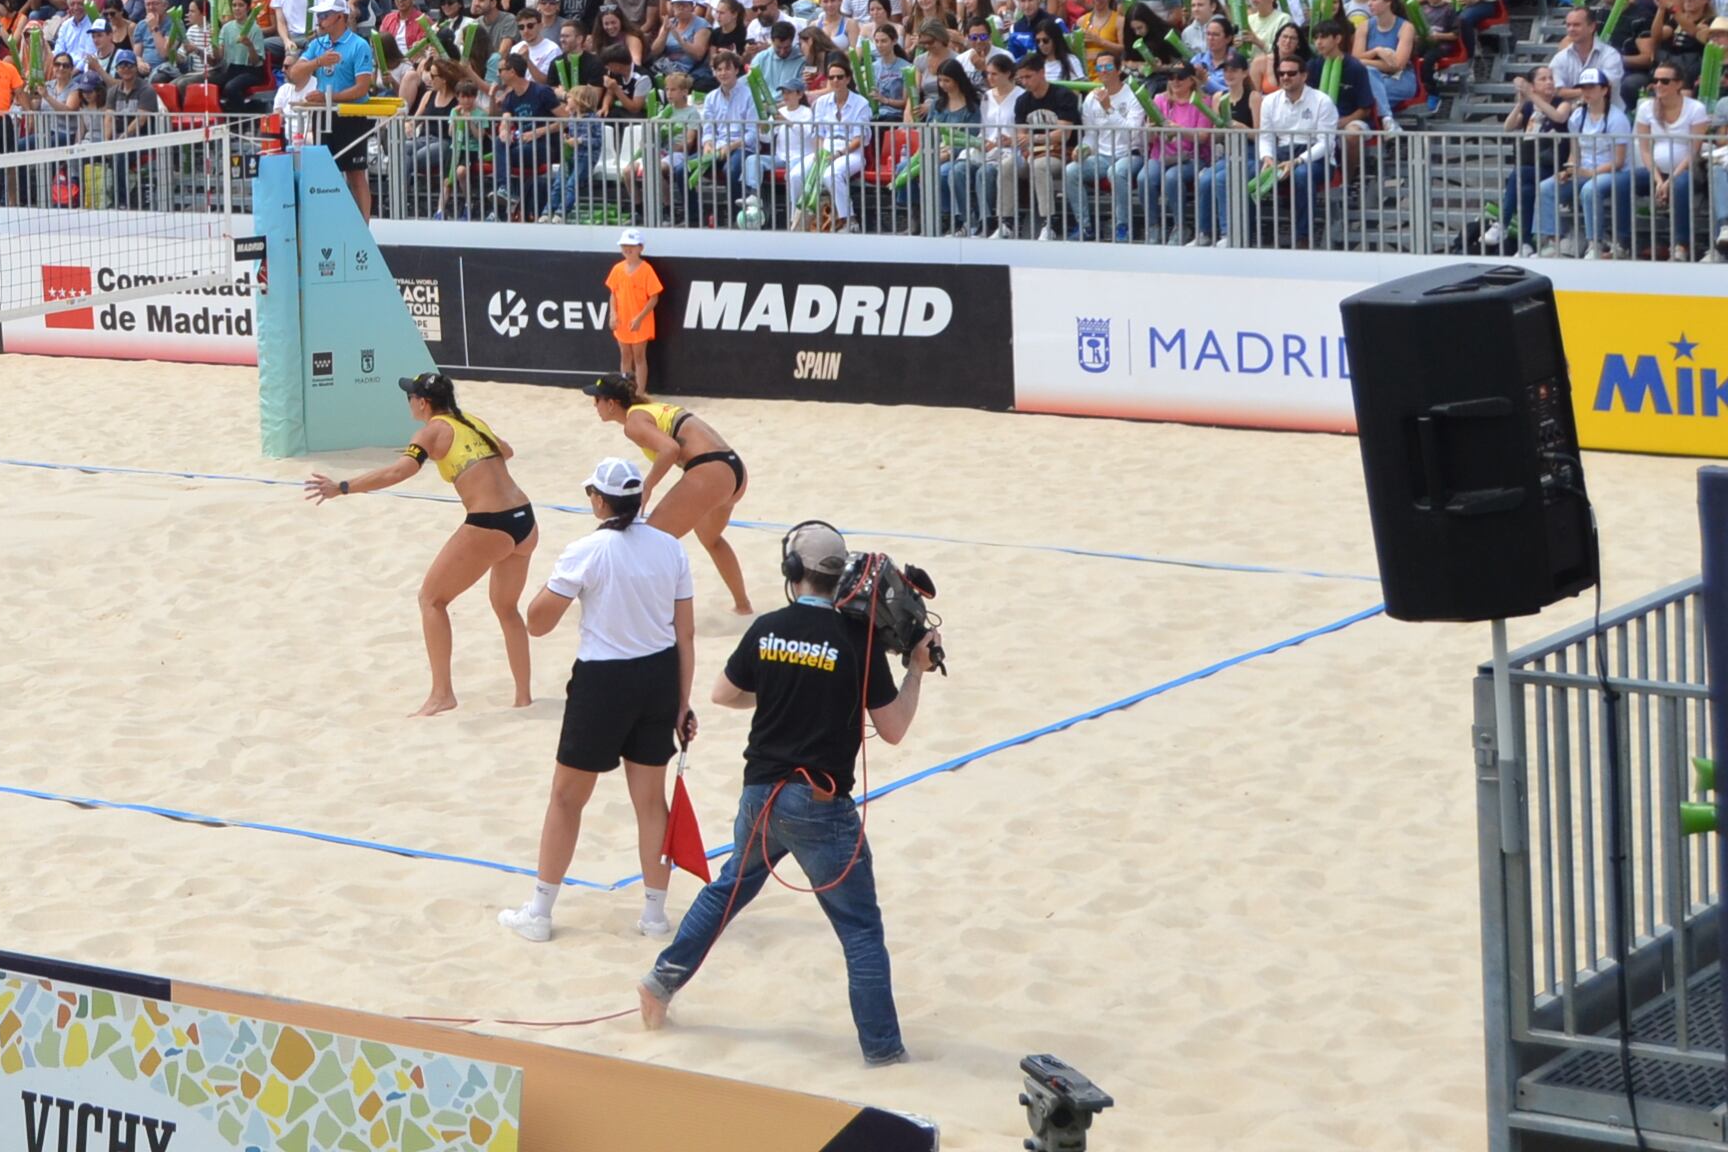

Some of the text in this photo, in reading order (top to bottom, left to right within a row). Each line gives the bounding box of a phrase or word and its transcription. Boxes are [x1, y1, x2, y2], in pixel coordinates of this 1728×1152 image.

[100, 303, 253, 336] de Madrid
[536, 299, 609, 330] CEV
[682, 279, 953, 337] MADRID
[793, 350, 841, 381] SPAIN
[759, 632, 839, 661] sinopsis
[759, 648, 836, 672] vuvuzela
[21, 1089, 177, 1152] VICHY
